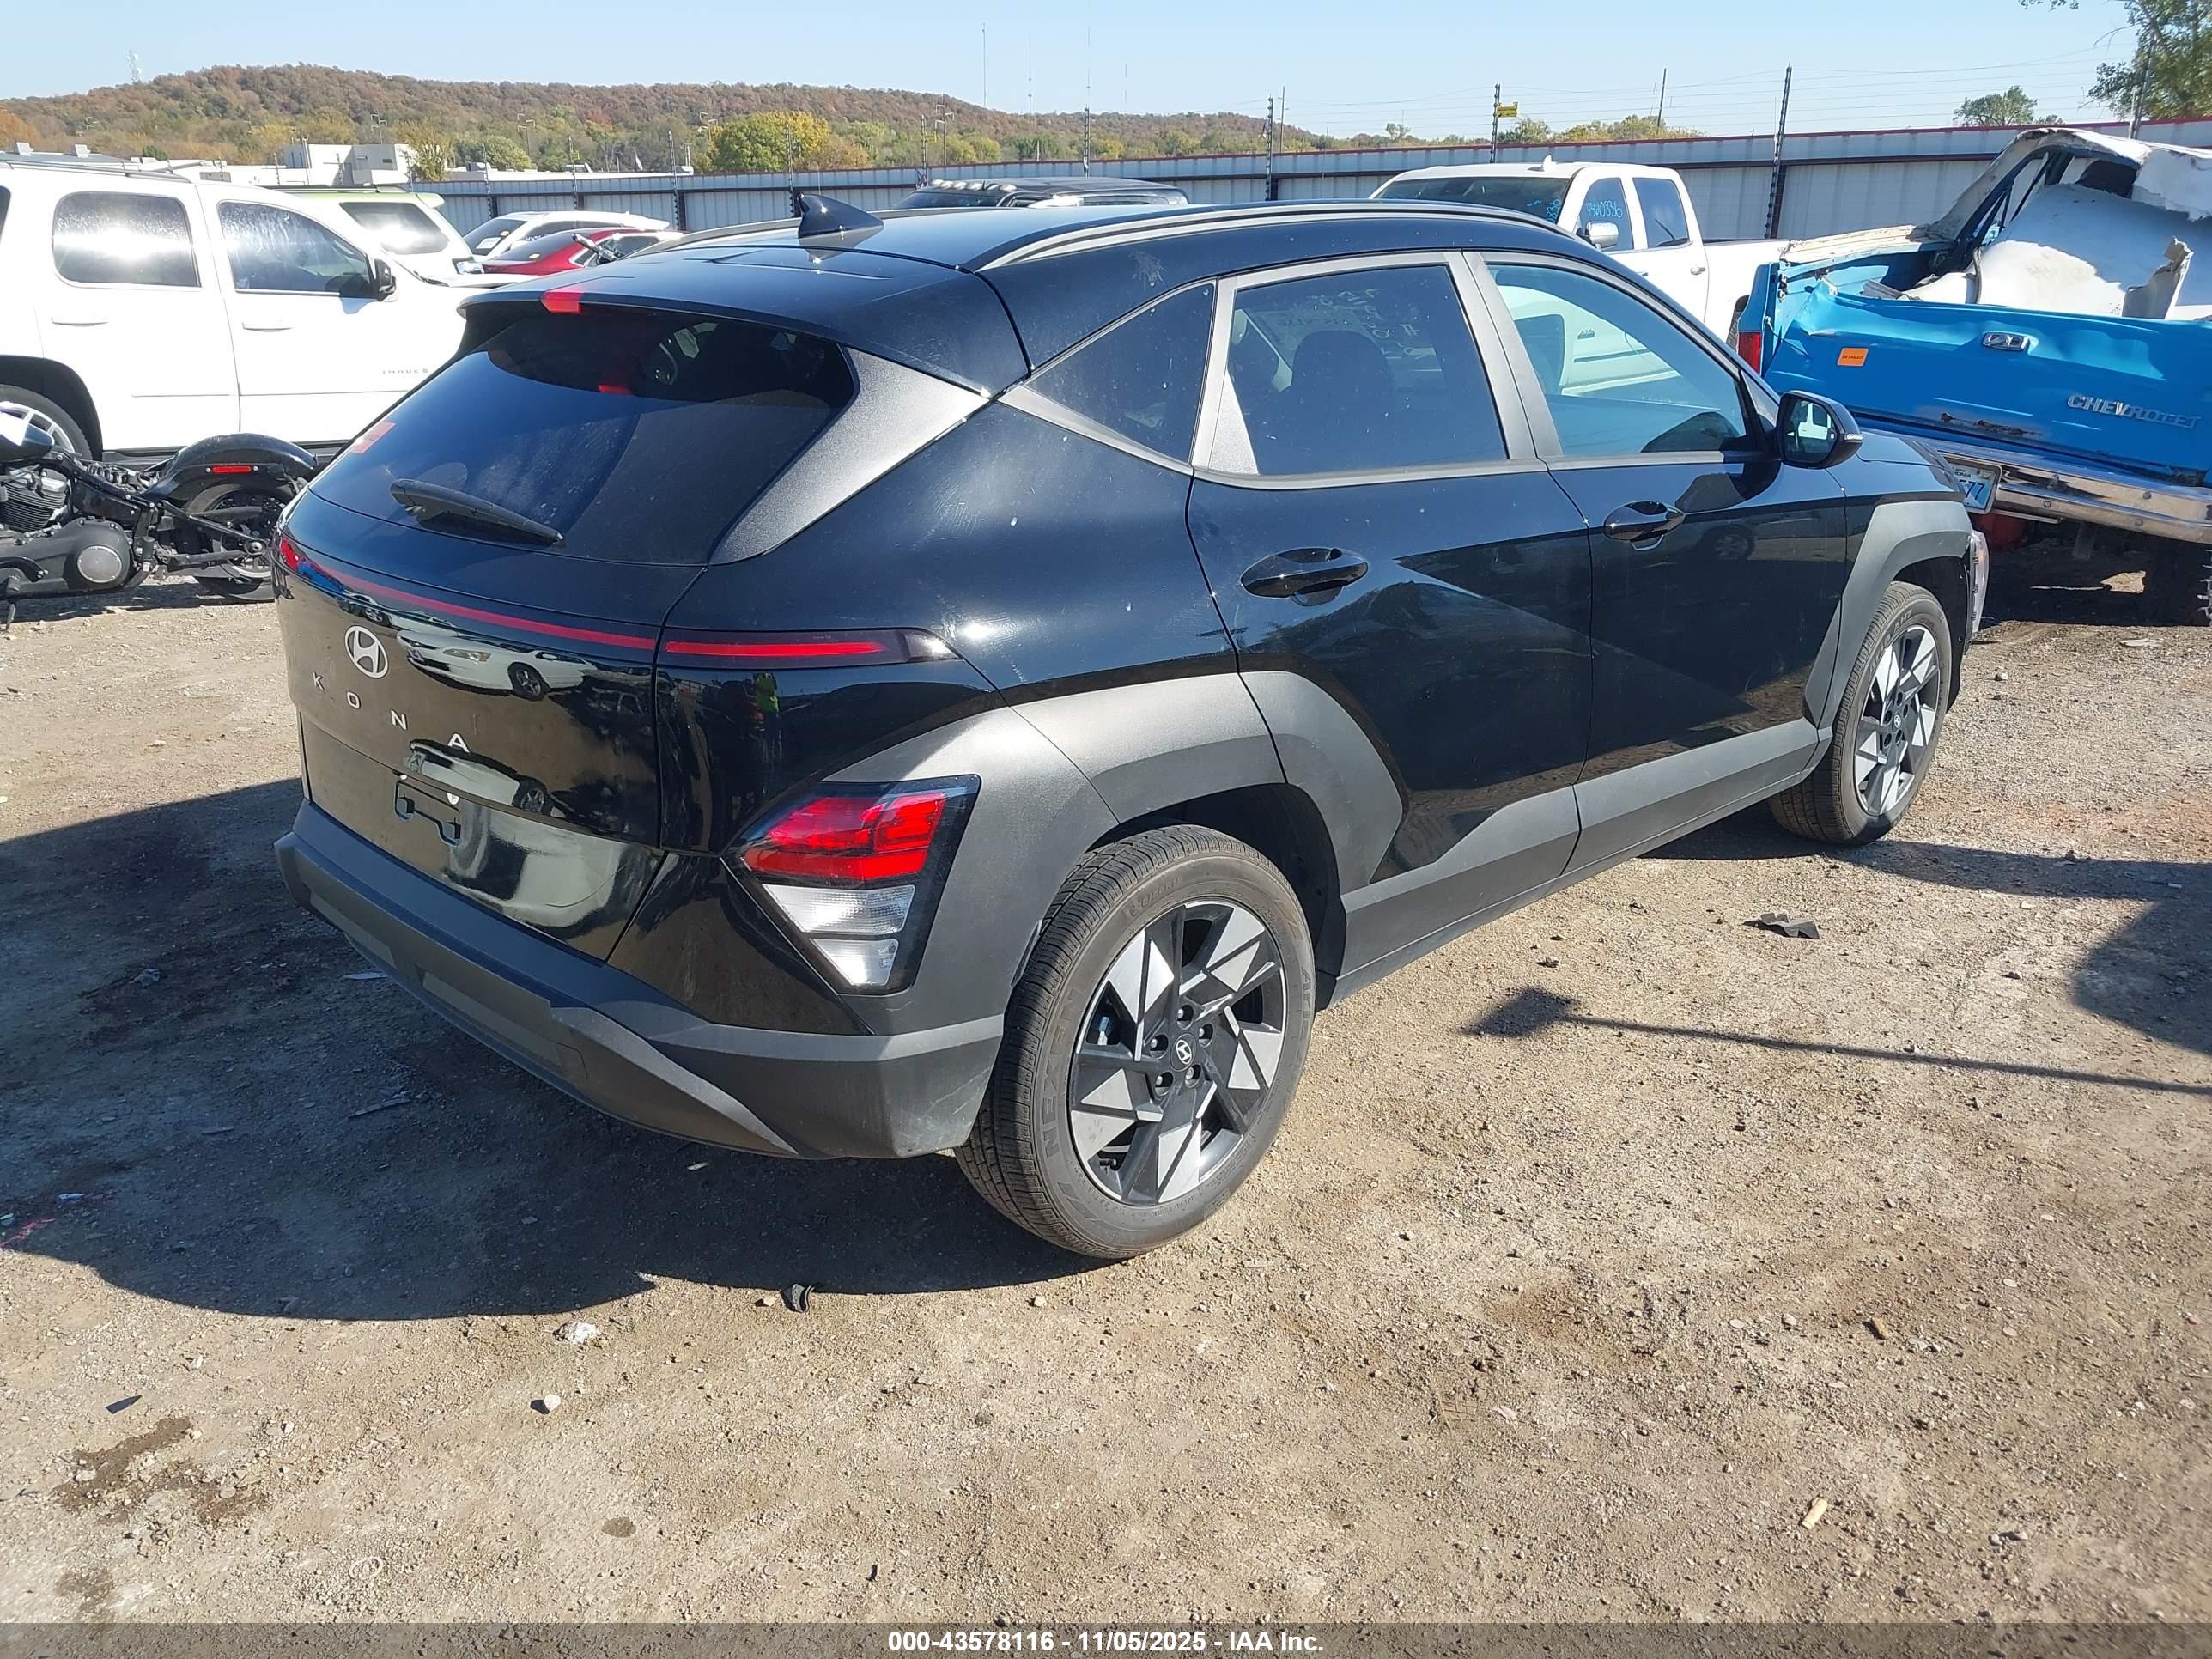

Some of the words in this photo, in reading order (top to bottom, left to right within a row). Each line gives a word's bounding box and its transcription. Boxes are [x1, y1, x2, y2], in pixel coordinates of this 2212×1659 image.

[2068, 394, 2201, 429] CHEVROLET
[1959, 478, 1985, 500] 77
[312, 672, 470, 753] KONA
[1042, 987, 1085, 1158] NEXEN
